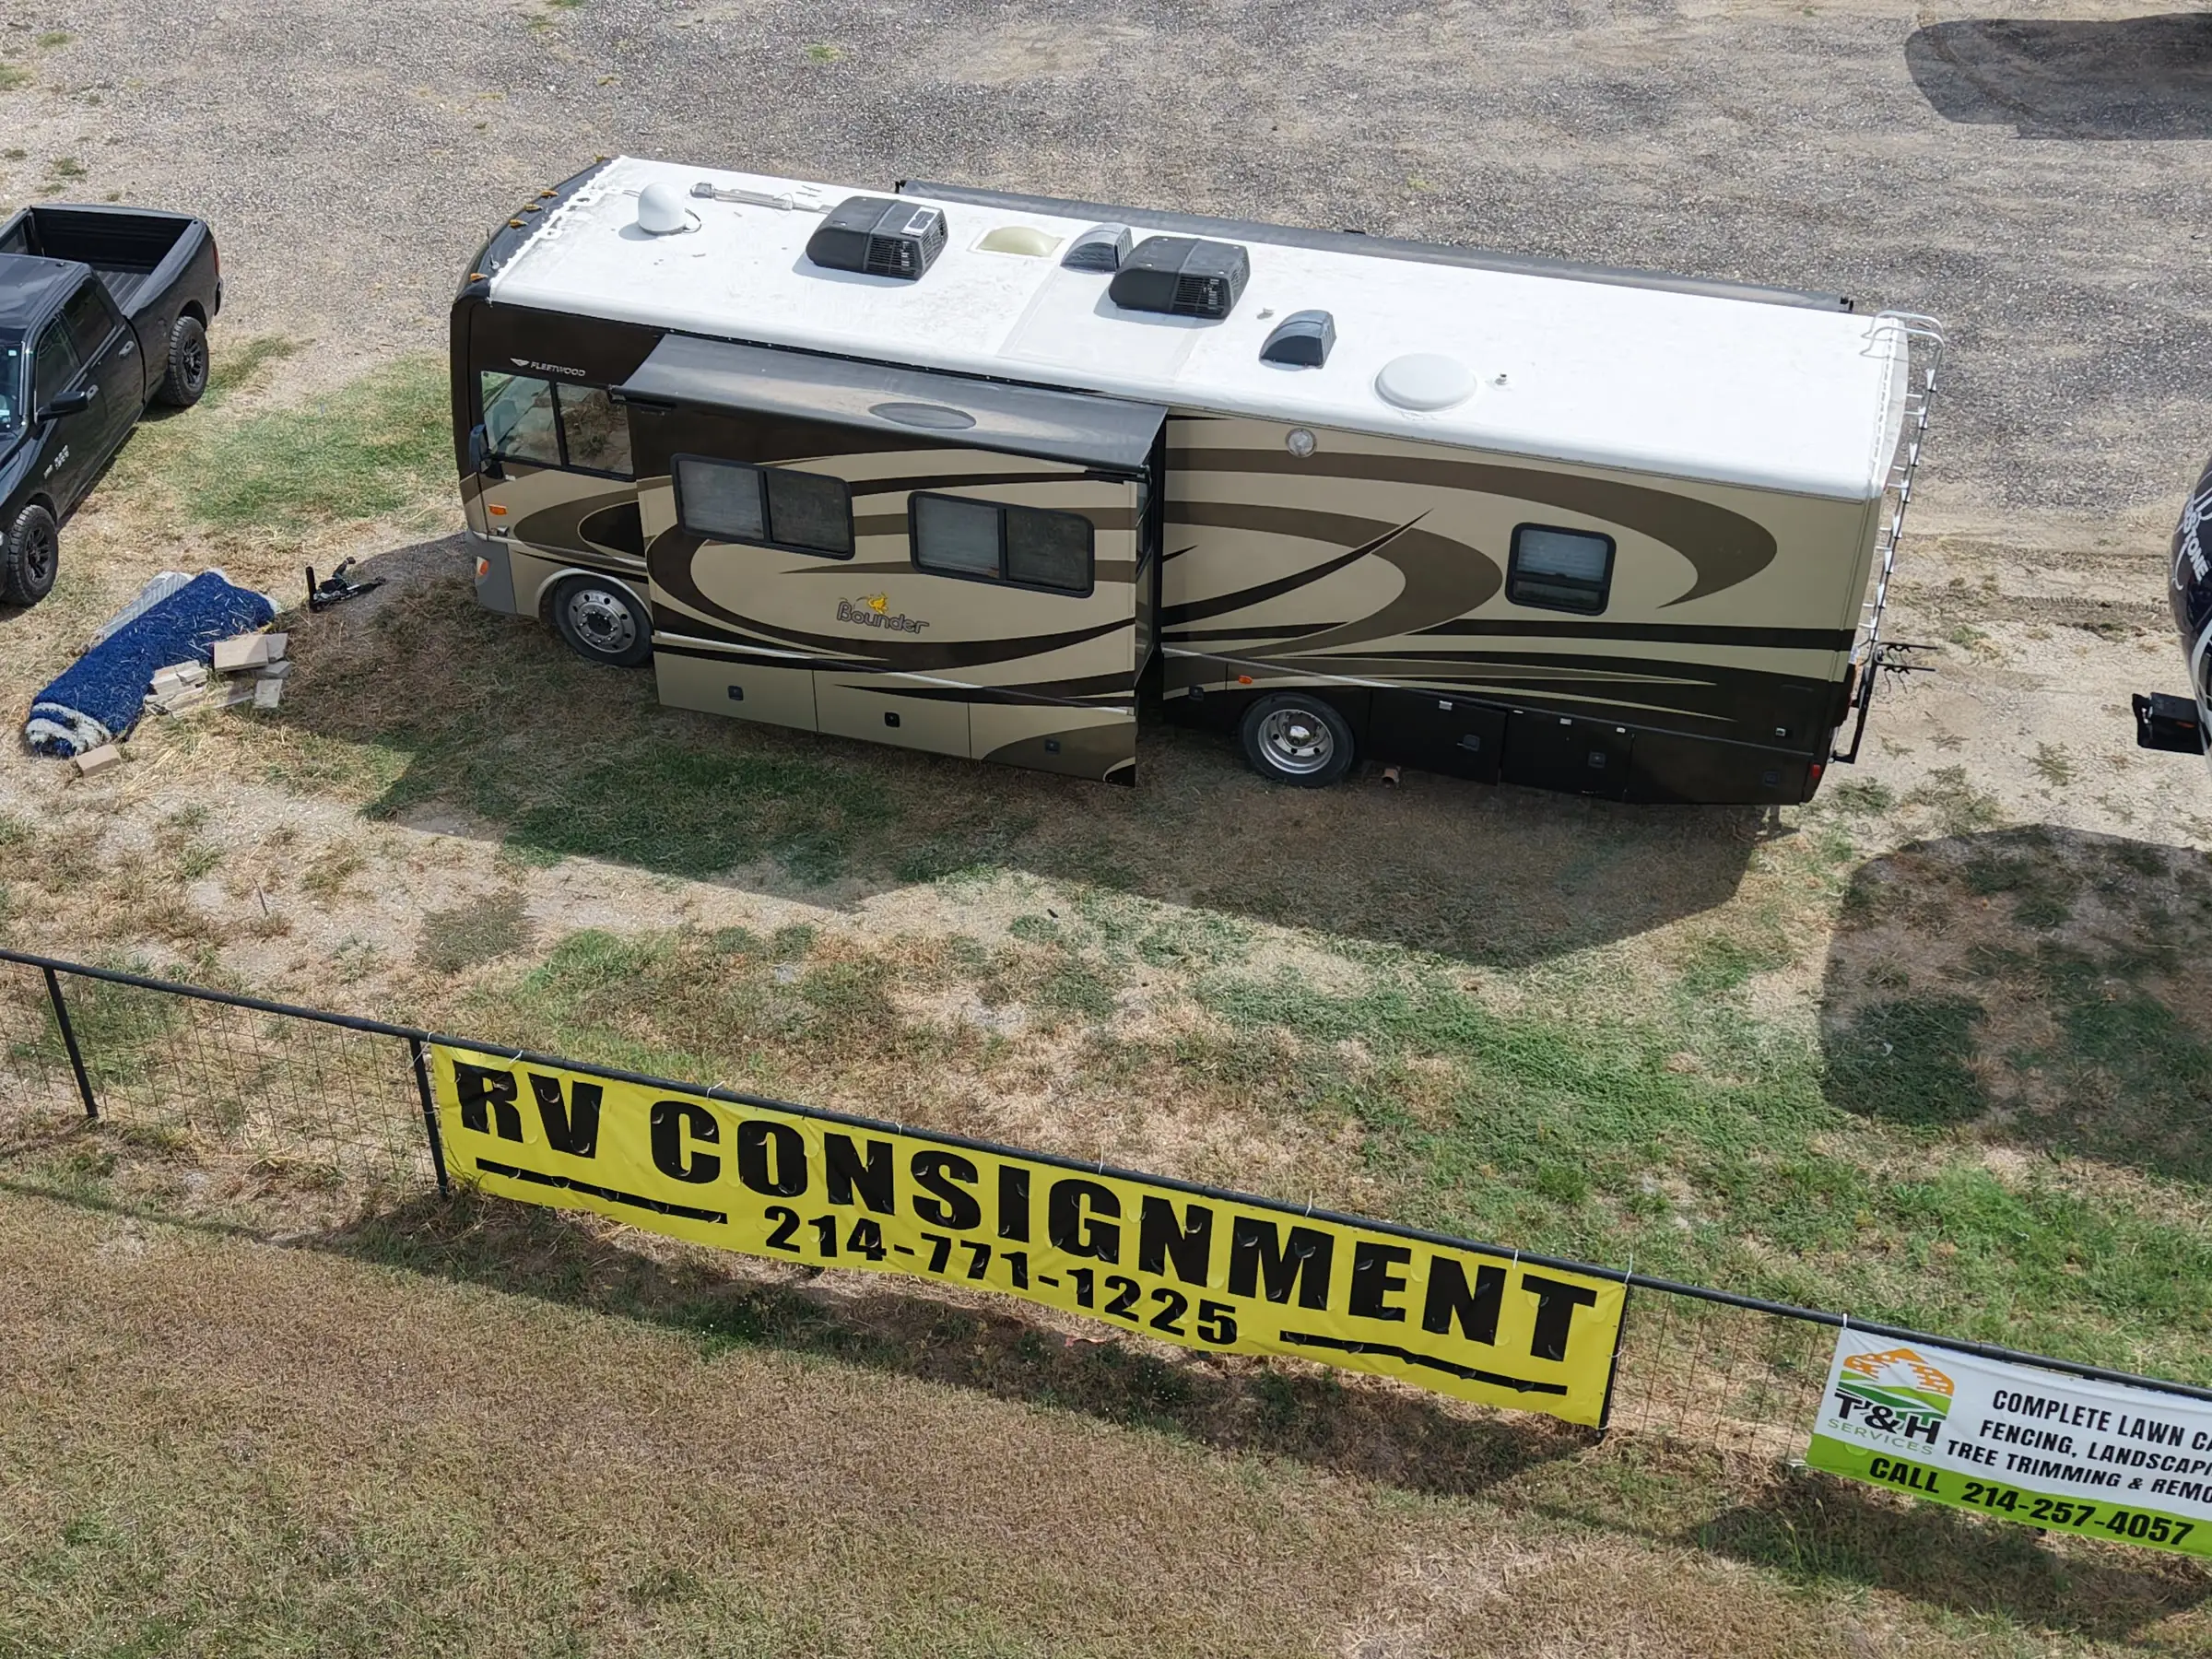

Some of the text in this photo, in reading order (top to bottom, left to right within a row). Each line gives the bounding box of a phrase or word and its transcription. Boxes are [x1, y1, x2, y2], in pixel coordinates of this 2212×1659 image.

[531, 361, 586, 377] FLEETWOOD
[837, 601, 930, 634] Bounder
[453, 1060, 1597, 1362] RV CONSIGNMENT
[765, 1206, 1239, 1345] 214-771-1225
[1828, 1418, 1934, 1456] SERVICES
[1980, 1419, 2077, 1458] FENCING,
[1993, 1390, 2112, 1432] COMPLETE
[2118, 1415, 2185, 1447] LAWN
[1947, 1440, 1998, 1466] TREE
[2006, 1453, 2122, 1488] TRIMMING
[2127, 1477, 2144, 1490] &
[1869, 1457, 2194, 1546] CALL 214-257-4057
